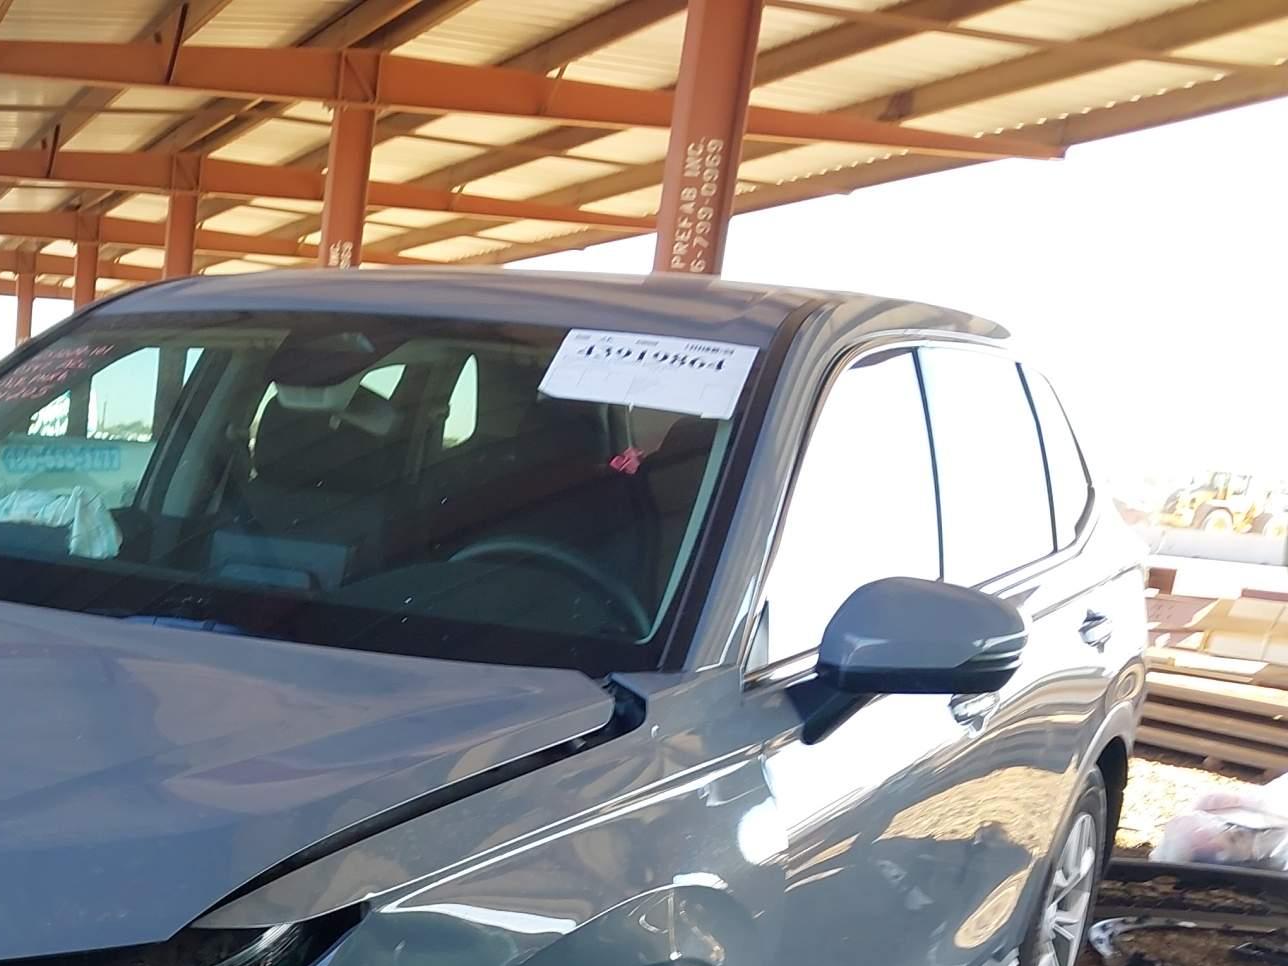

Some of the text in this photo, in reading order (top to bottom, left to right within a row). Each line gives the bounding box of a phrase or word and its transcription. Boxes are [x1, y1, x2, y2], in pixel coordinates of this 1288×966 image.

[671, 136, 706, 269] PREFAB INC.
[576, 344, 727, 372] 43919864
